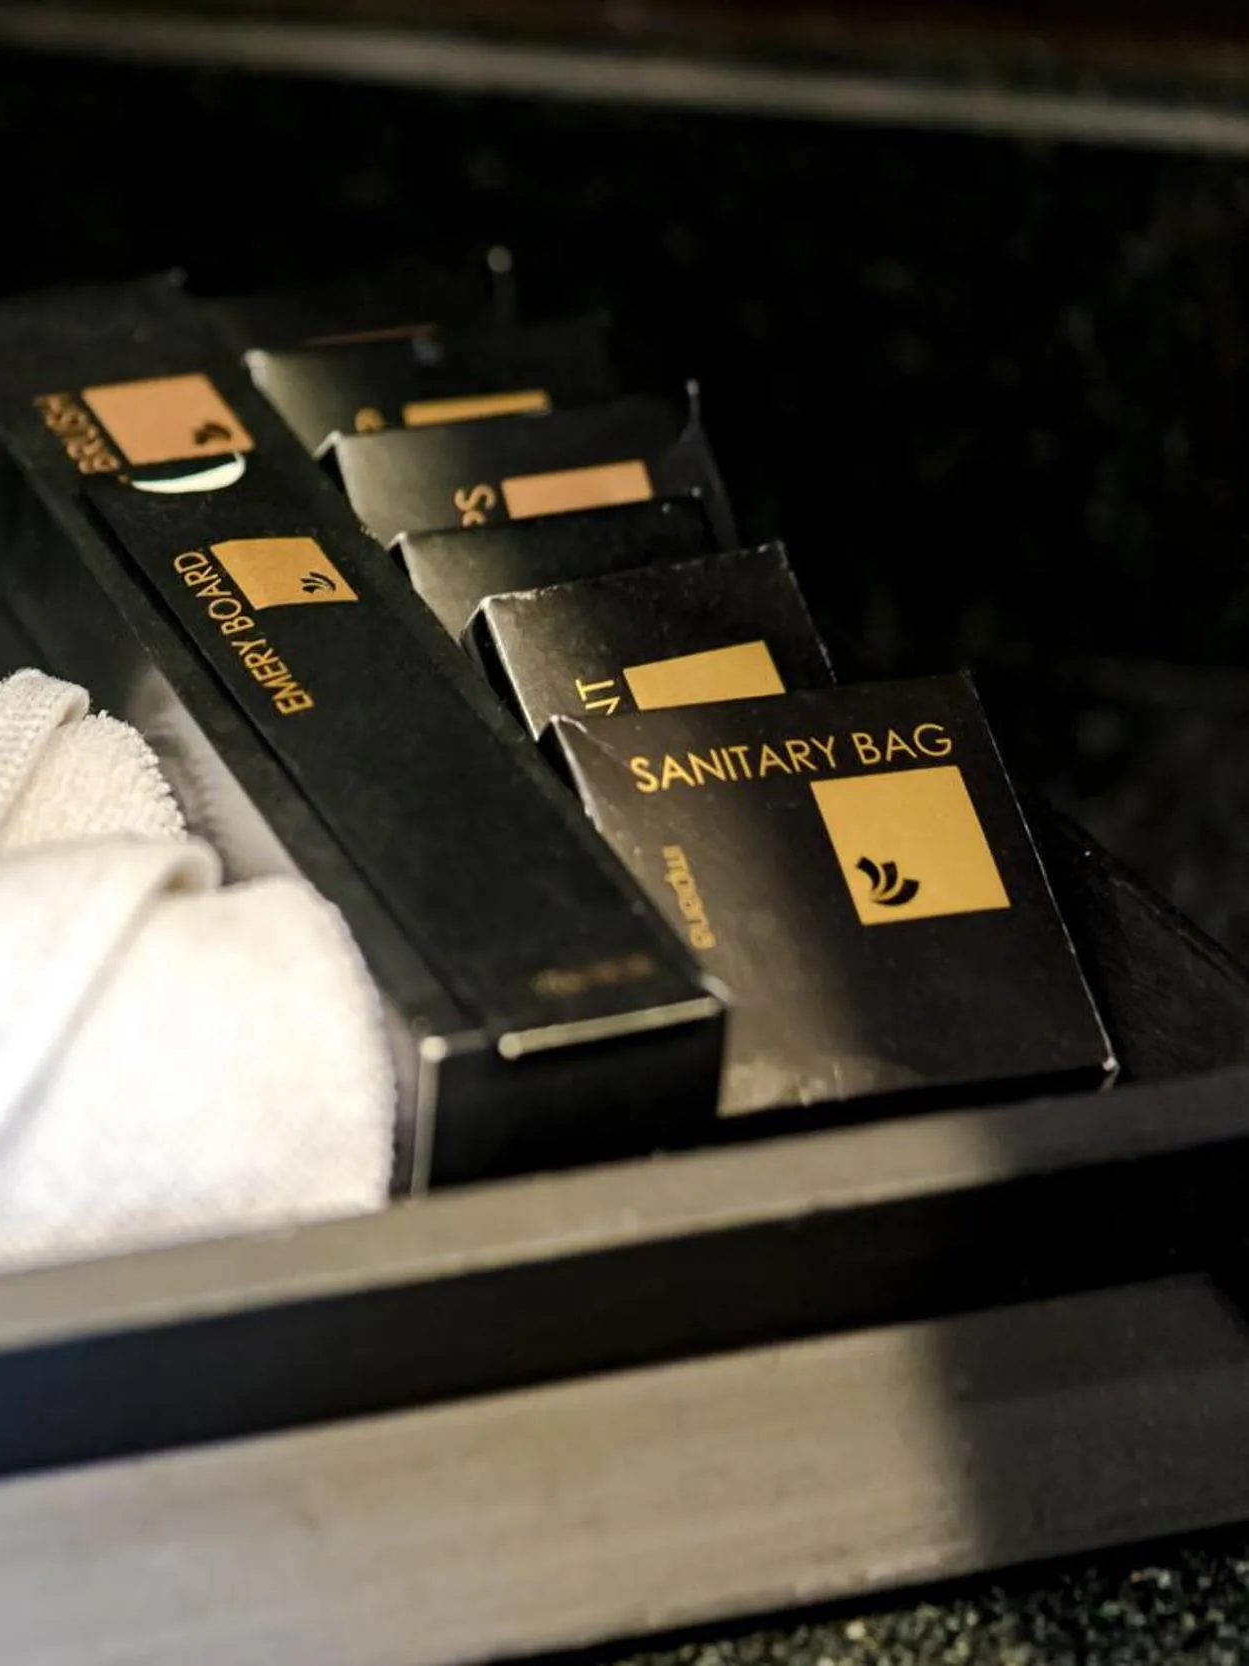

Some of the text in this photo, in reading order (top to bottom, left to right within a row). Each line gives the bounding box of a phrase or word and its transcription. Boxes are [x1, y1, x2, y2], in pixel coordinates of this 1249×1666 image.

[173, 550, 313, 716] EMERY BOARD
[629, 722, 952, 793] SANITARY BAG
